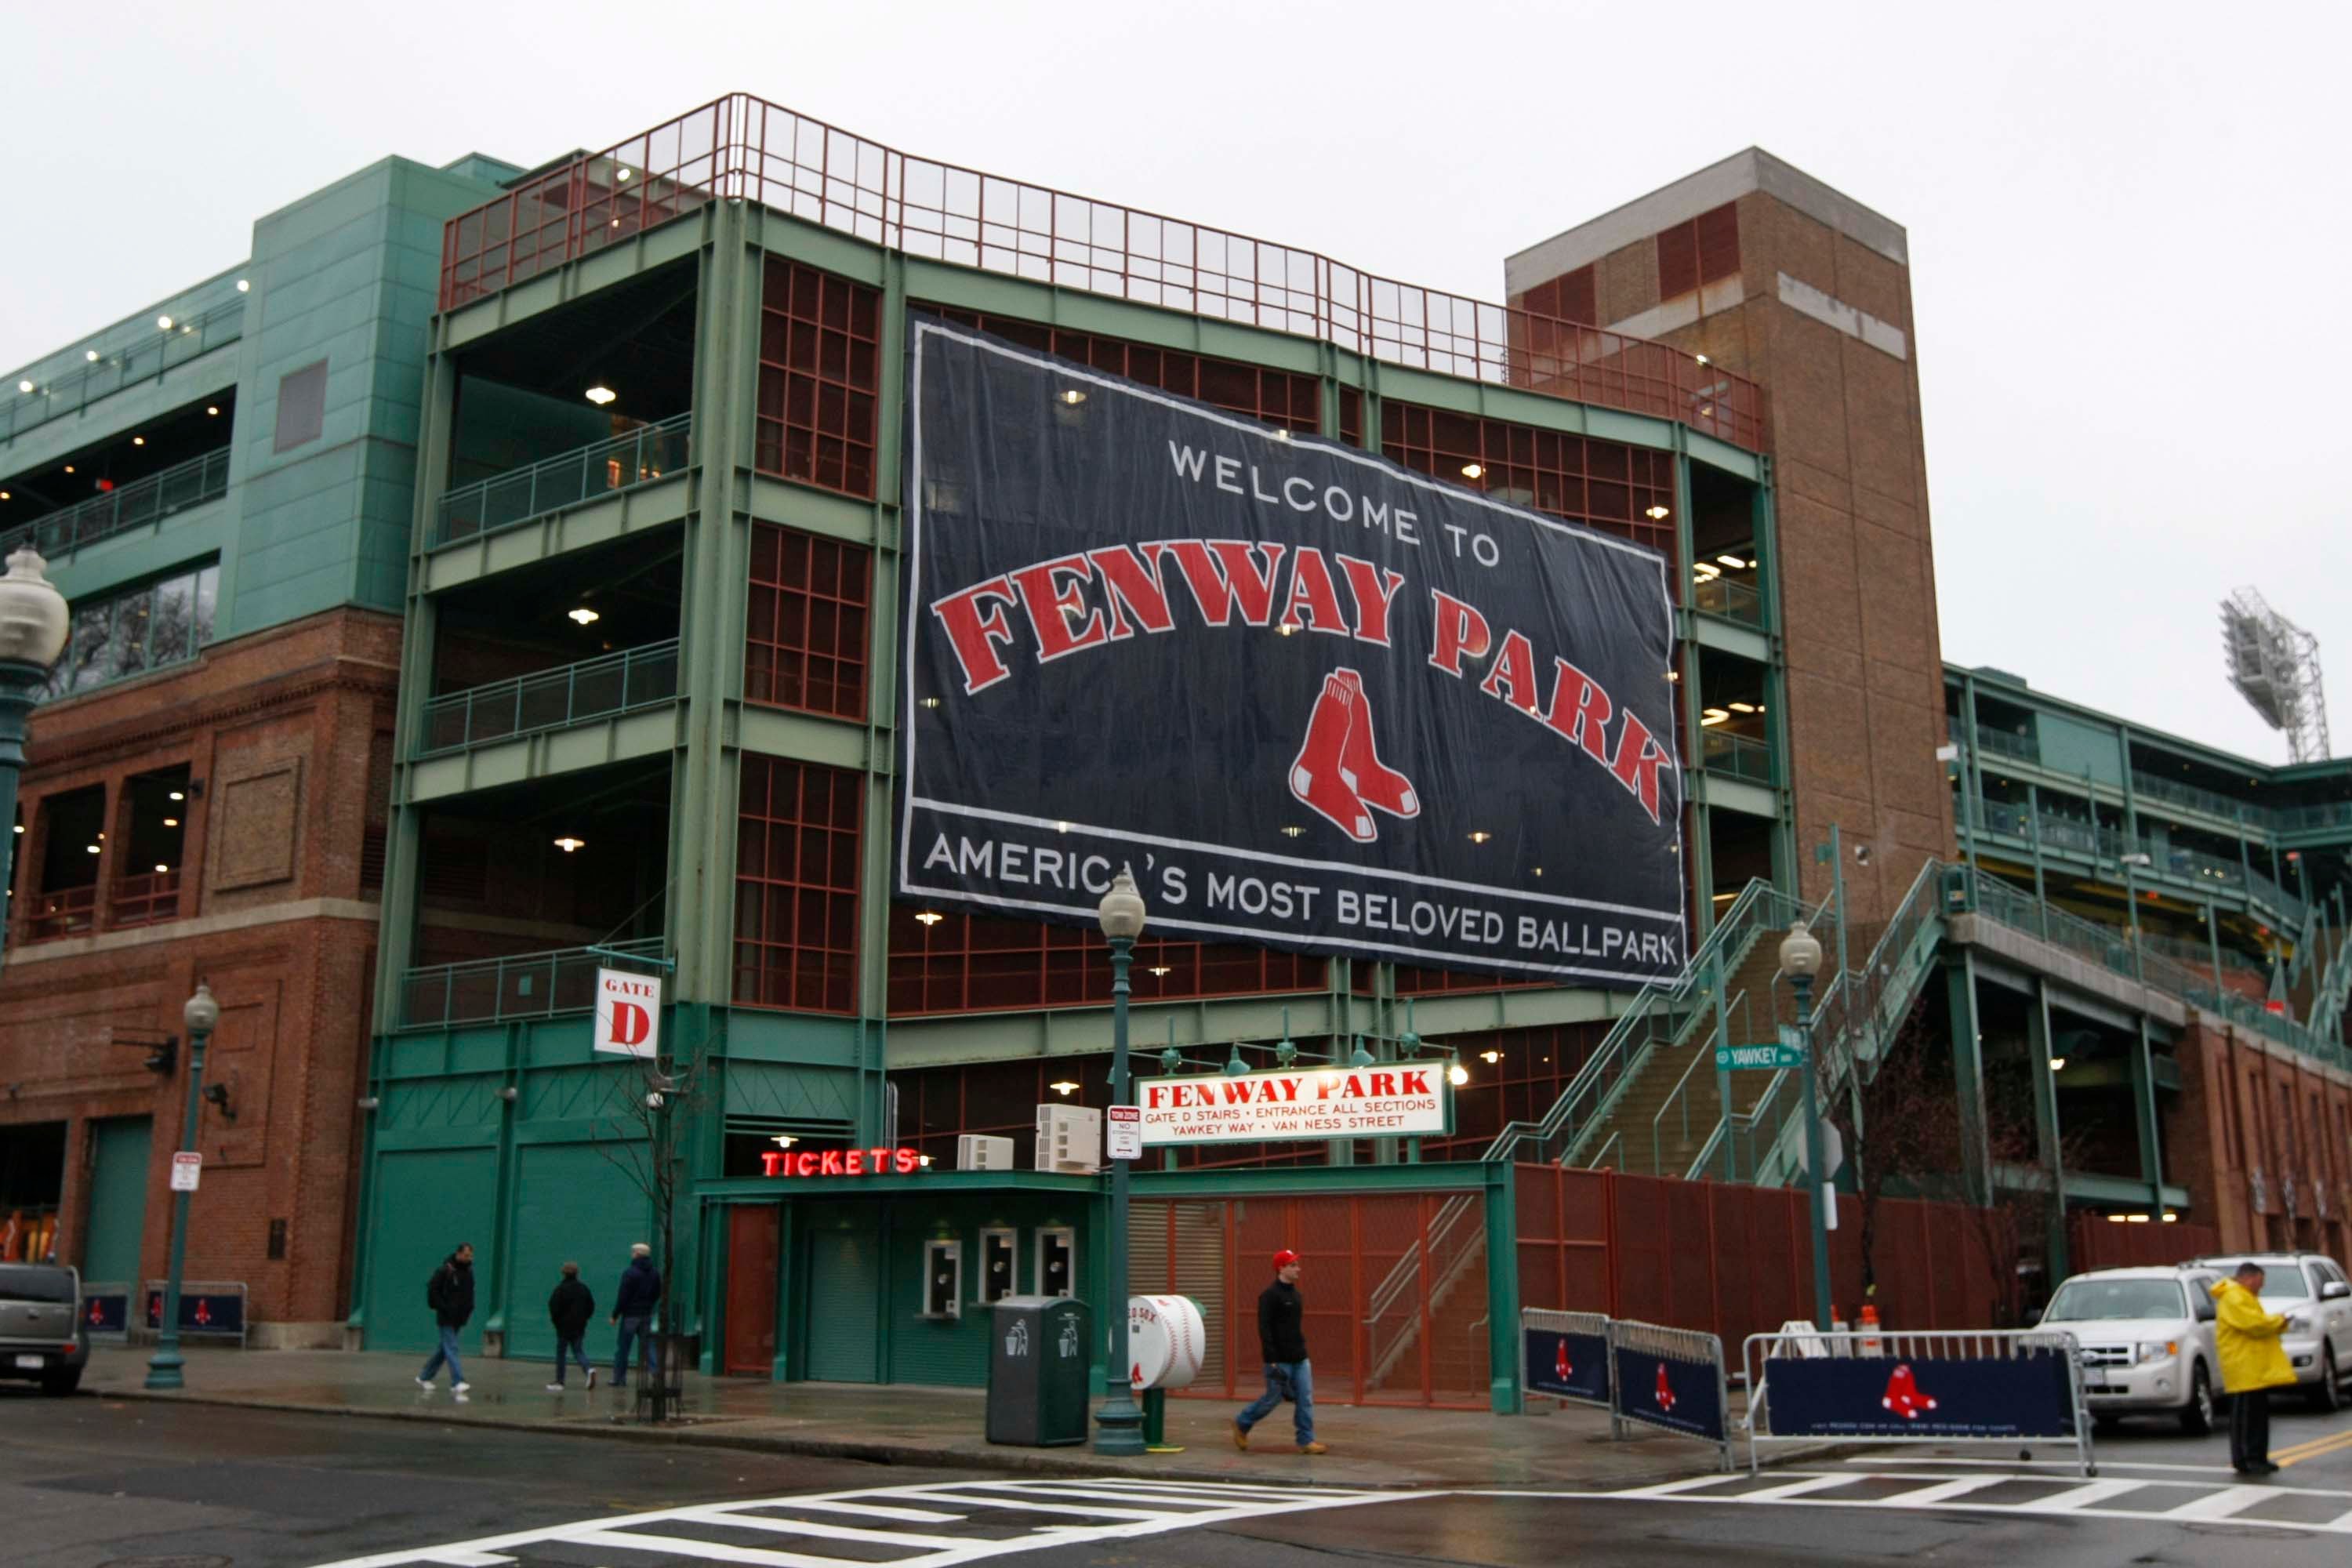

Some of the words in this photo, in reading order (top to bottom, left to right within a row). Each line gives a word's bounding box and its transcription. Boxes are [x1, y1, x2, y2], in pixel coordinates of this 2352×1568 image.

[1168, 439, 1420, 545] WELCOME
[1445, 524, 1500, 566] TO
[930, 539, 1404, 695] FENWAY
[1428, 587, 1672, 826] PARK
[1207, 872, 1320, 920] MOST
[1338, 890, 1504, 944] BELOVED
[1518, 916, 1679, 965] BALLPARK
[605, 978, 655, 998] GATE
[608, 1000, 650, 1045] D
[1731, 1047, 1778, 1065] YAWKEY
[1148, 1078, 1303, 1109] FENWAY
[1316, 1070, 1432, 1100] PARK
[1145, 1112, 1176, 1123] GATE
[1182, 1112, 1192, 1122] D
[1196, 1109, 1240, 1120] STAIRS
[1256, 1104, 1327, 1118] ENTRANCE
[1333, 1102, 1357, 1114] ALL
[1364, 1098, 1436, 1112] SECTIONS
[1173, 1123, 1222, 1135] YAWKEY
[1229, 1122, 1254, 1134] WAY
[1272, 1120, 1298, 1131] VAN
[1305, 1118, 1341, 1129] NESS
[1348, 1115, 1404, 1128] STREET
[761, 1148, 920, 1177] TICKETS
